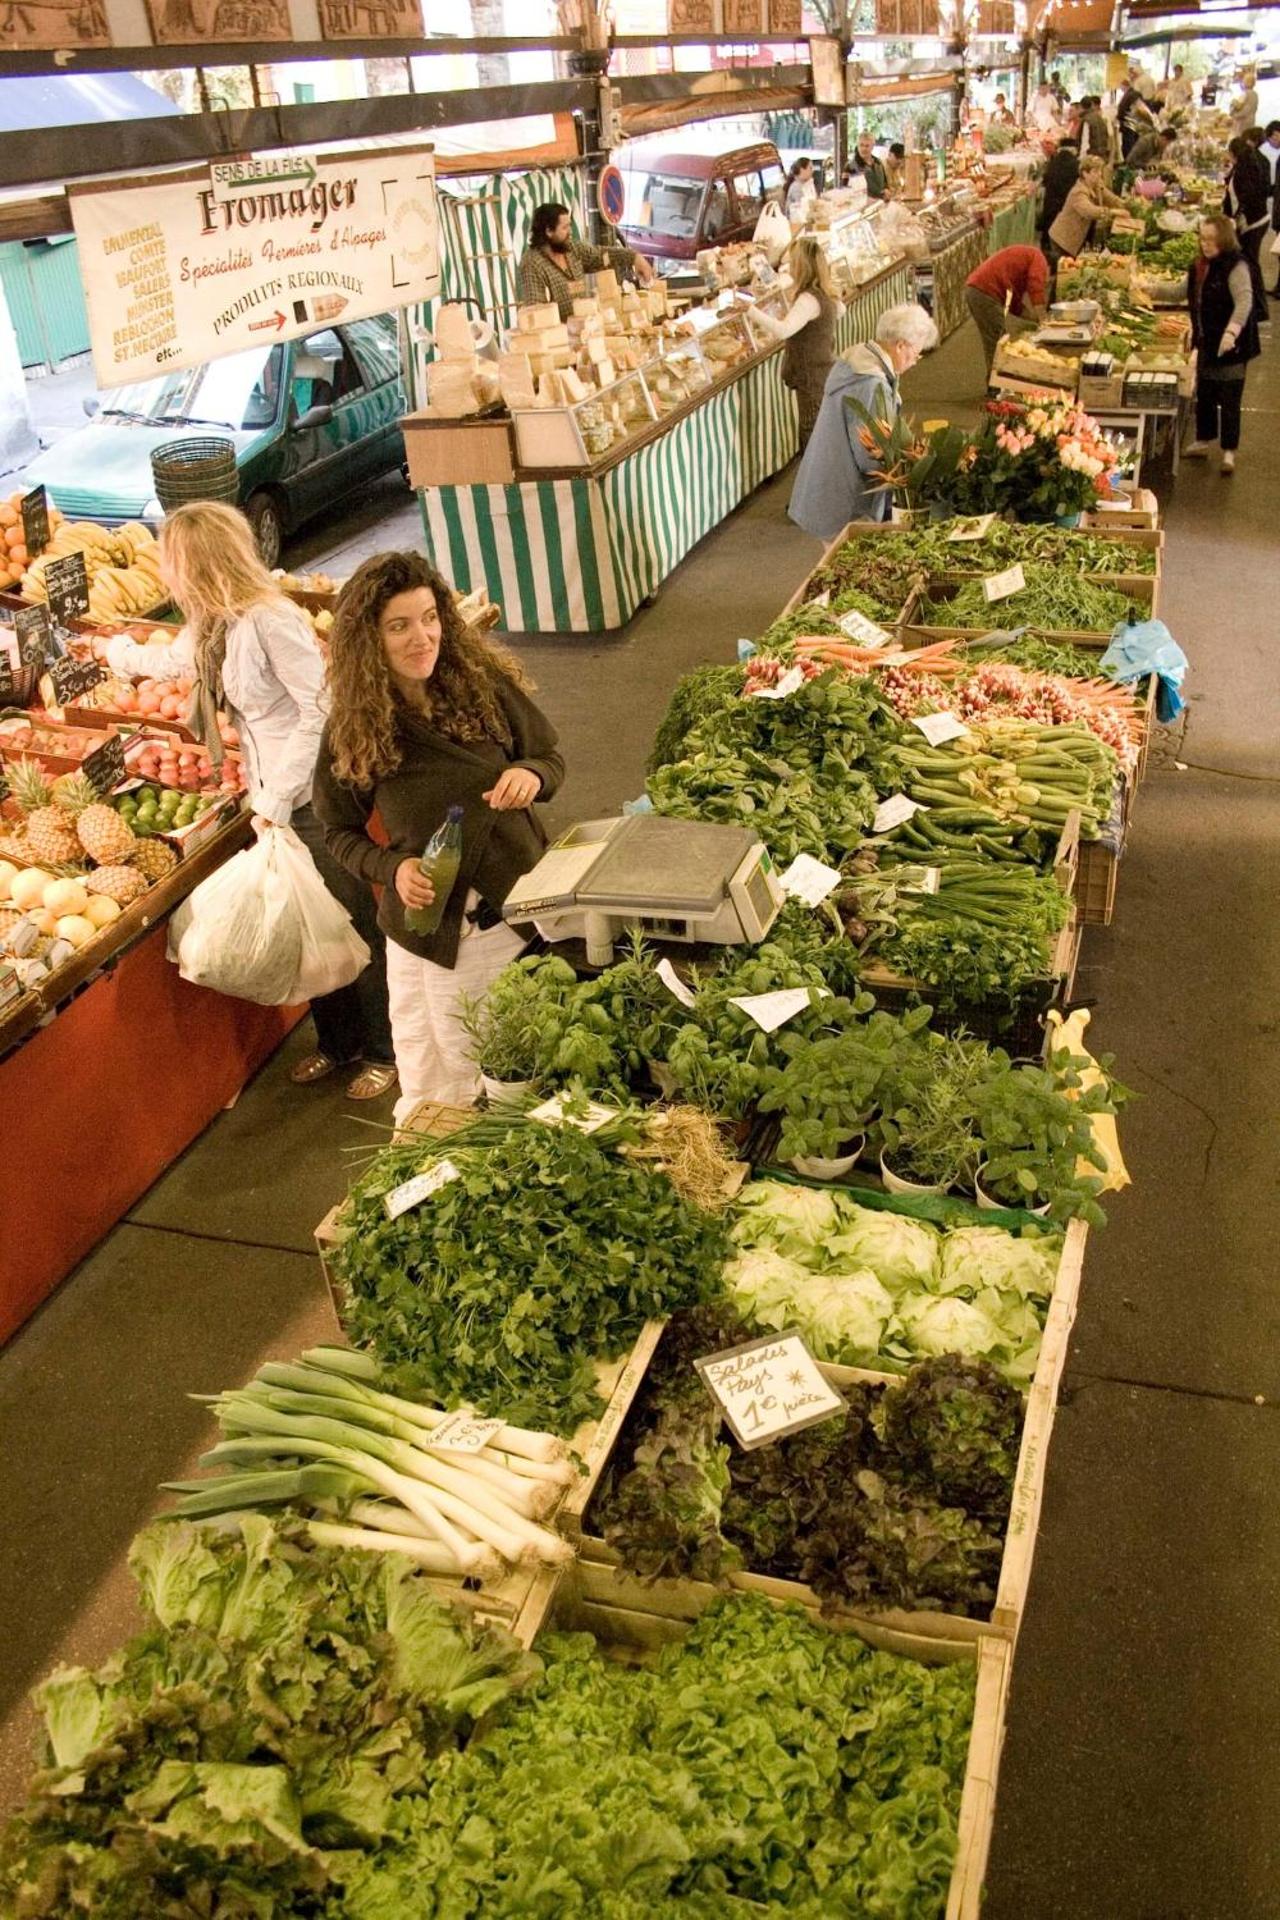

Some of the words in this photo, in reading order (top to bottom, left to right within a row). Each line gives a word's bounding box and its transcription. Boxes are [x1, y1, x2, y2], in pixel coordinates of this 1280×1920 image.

[214, 161, 244, 183] SENS
[248, 161, 262, 179] DE
[266, 160, 280, 177] LA
[283, 157, 305, 173] FILE
[196, 177, 358, 235] Fromager
[213, 277, 284, 335] PRODUITS
[287, 269, 365, 295] REGIONAUX
[113, 306, 175, 347] REBLOCHON
[710, 1345, 789, 1385] Salades
[725, 1367, 774, 1397] Pays
